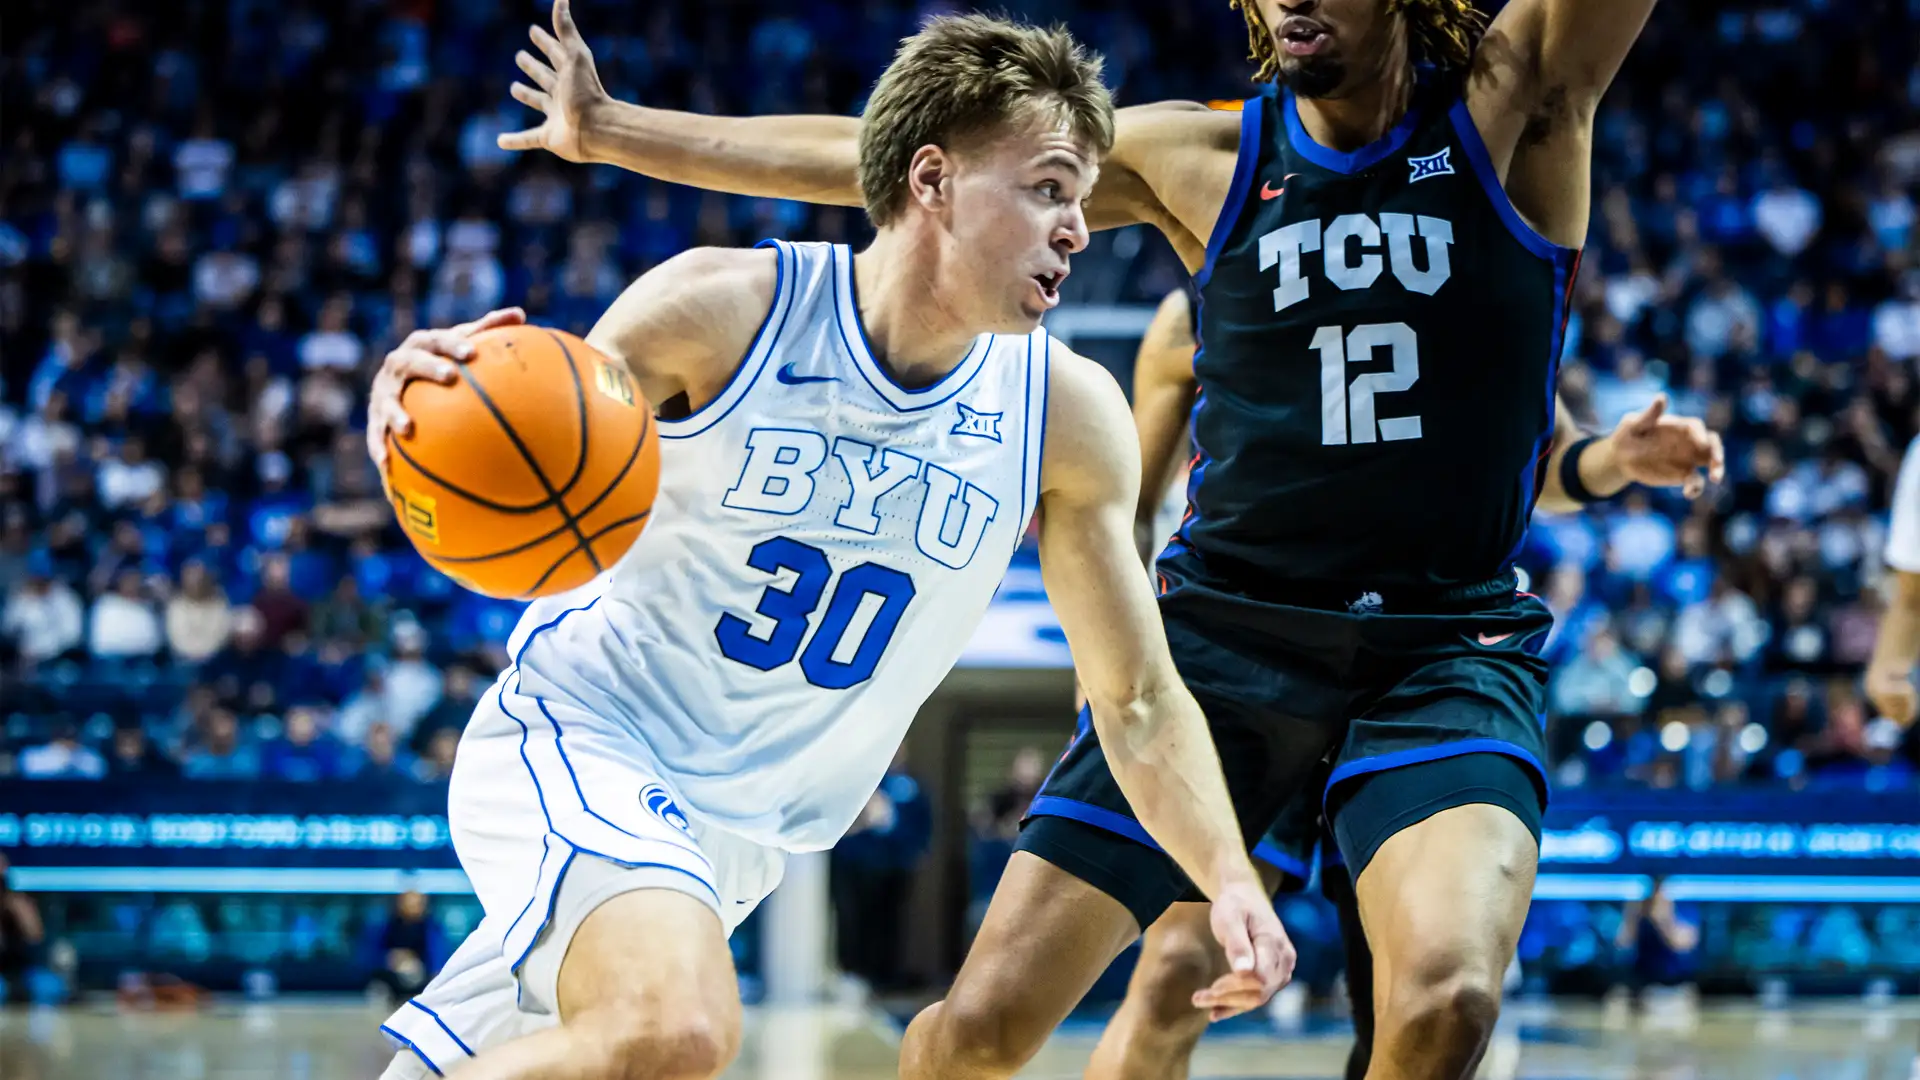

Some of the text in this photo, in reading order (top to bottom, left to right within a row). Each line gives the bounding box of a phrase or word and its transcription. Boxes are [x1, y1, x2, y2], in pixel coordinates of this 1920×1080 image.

[1408, 146, 1455, 183] XII
[1259, 212, 1454, 312] TCU
[1308, 322, 1422, 445] 12
[722, 428, 999, 570] BYU
[714, 535, 916, 689] 30
